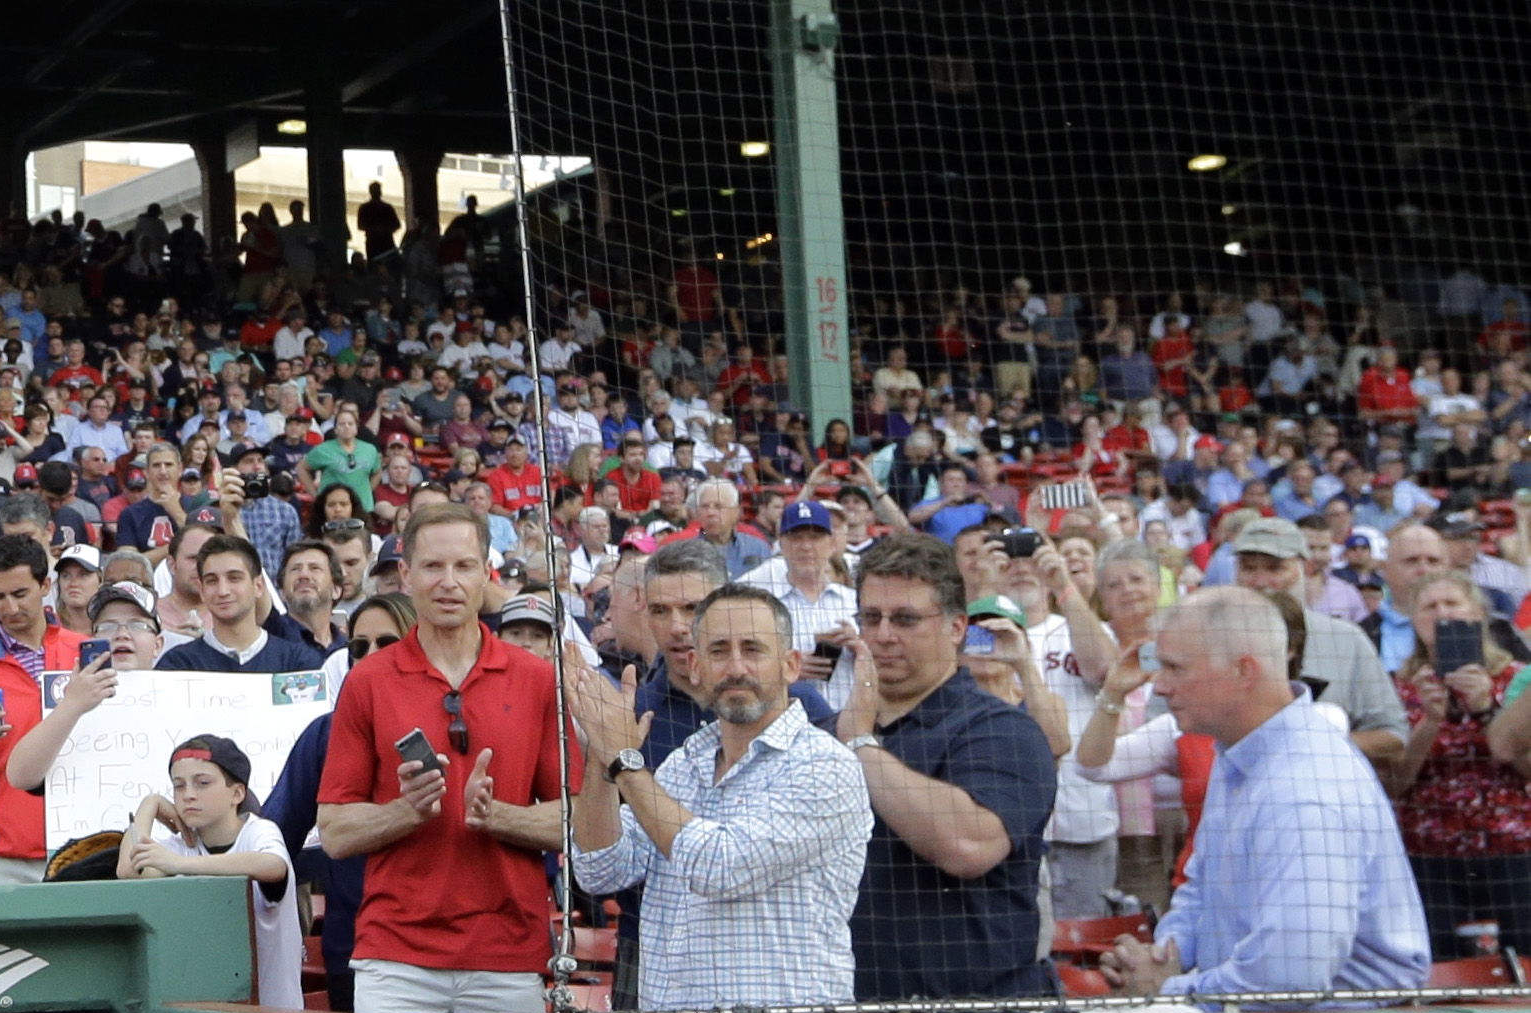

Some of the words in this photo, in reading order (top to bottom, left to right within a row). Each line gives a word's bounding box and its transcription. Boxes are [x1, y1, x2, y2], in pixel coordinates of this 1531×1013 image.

[815, 276, 838, 303] 16
[818, 321, 839, 349] 17
[1045, 652, 1081, 677] SO
[174, 678, 248, 709] Time
[221, 728, 297, 757] Tonig
[49, 765, 84, 796] At
